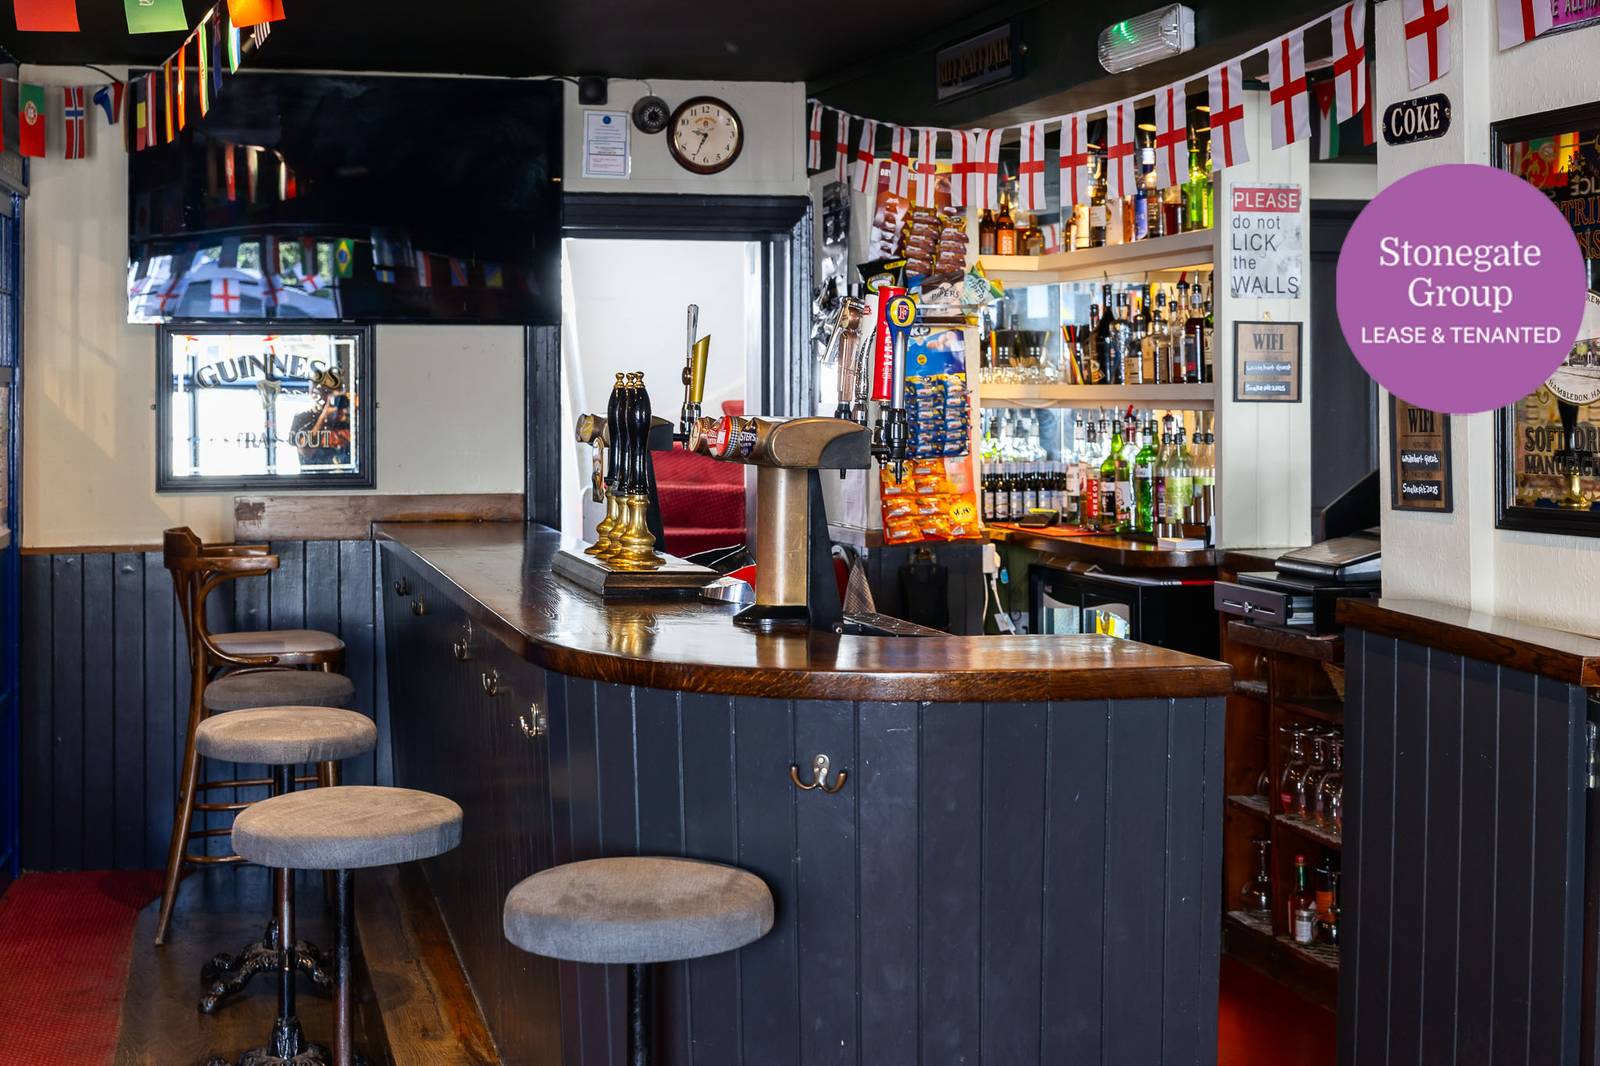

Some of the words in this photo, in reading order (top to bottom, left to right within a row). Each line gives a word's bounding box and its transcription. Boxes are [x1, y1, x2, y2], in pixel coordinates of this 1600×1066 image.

[1391, 102, 1440, 137] COKE
[1234, 191, 1298, 209] PLEASE
[1233, 214, 1250, 229] do
[1257, 215, 1281, 230] not
[1232, 233, 1277, 251] LICK
[1233, 255, 1256, 270] the
[1233, 276, 1299, 294] WALLS
[898, 305, 909, 320] F
[1253, 333, 1284, 351] WIFI
[196, 353, 344, 389] GUINNESS
[1524, 424, 1566, 452] SOFT
